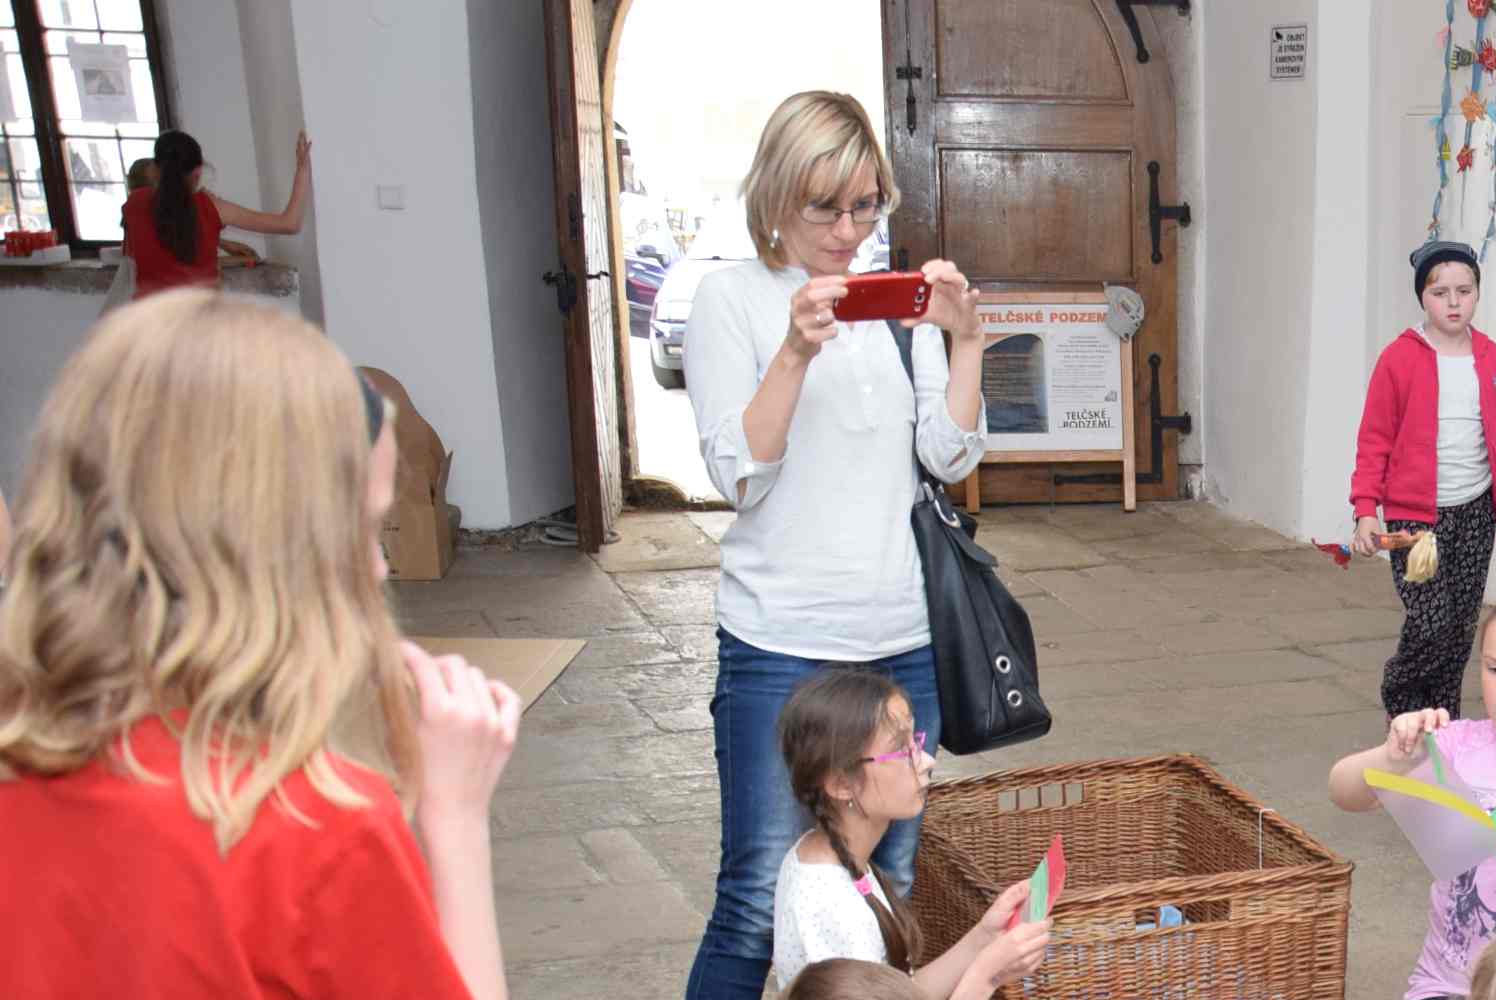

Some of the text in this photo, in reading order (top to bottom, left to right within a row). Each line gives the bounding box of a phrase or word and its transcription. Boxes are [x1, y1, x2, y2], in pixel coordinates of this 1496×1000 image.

[979, 310, 1108, 323] TELČSKÉ PODZEM
[1065, 408, 1107, 420] TELČSKÉ
